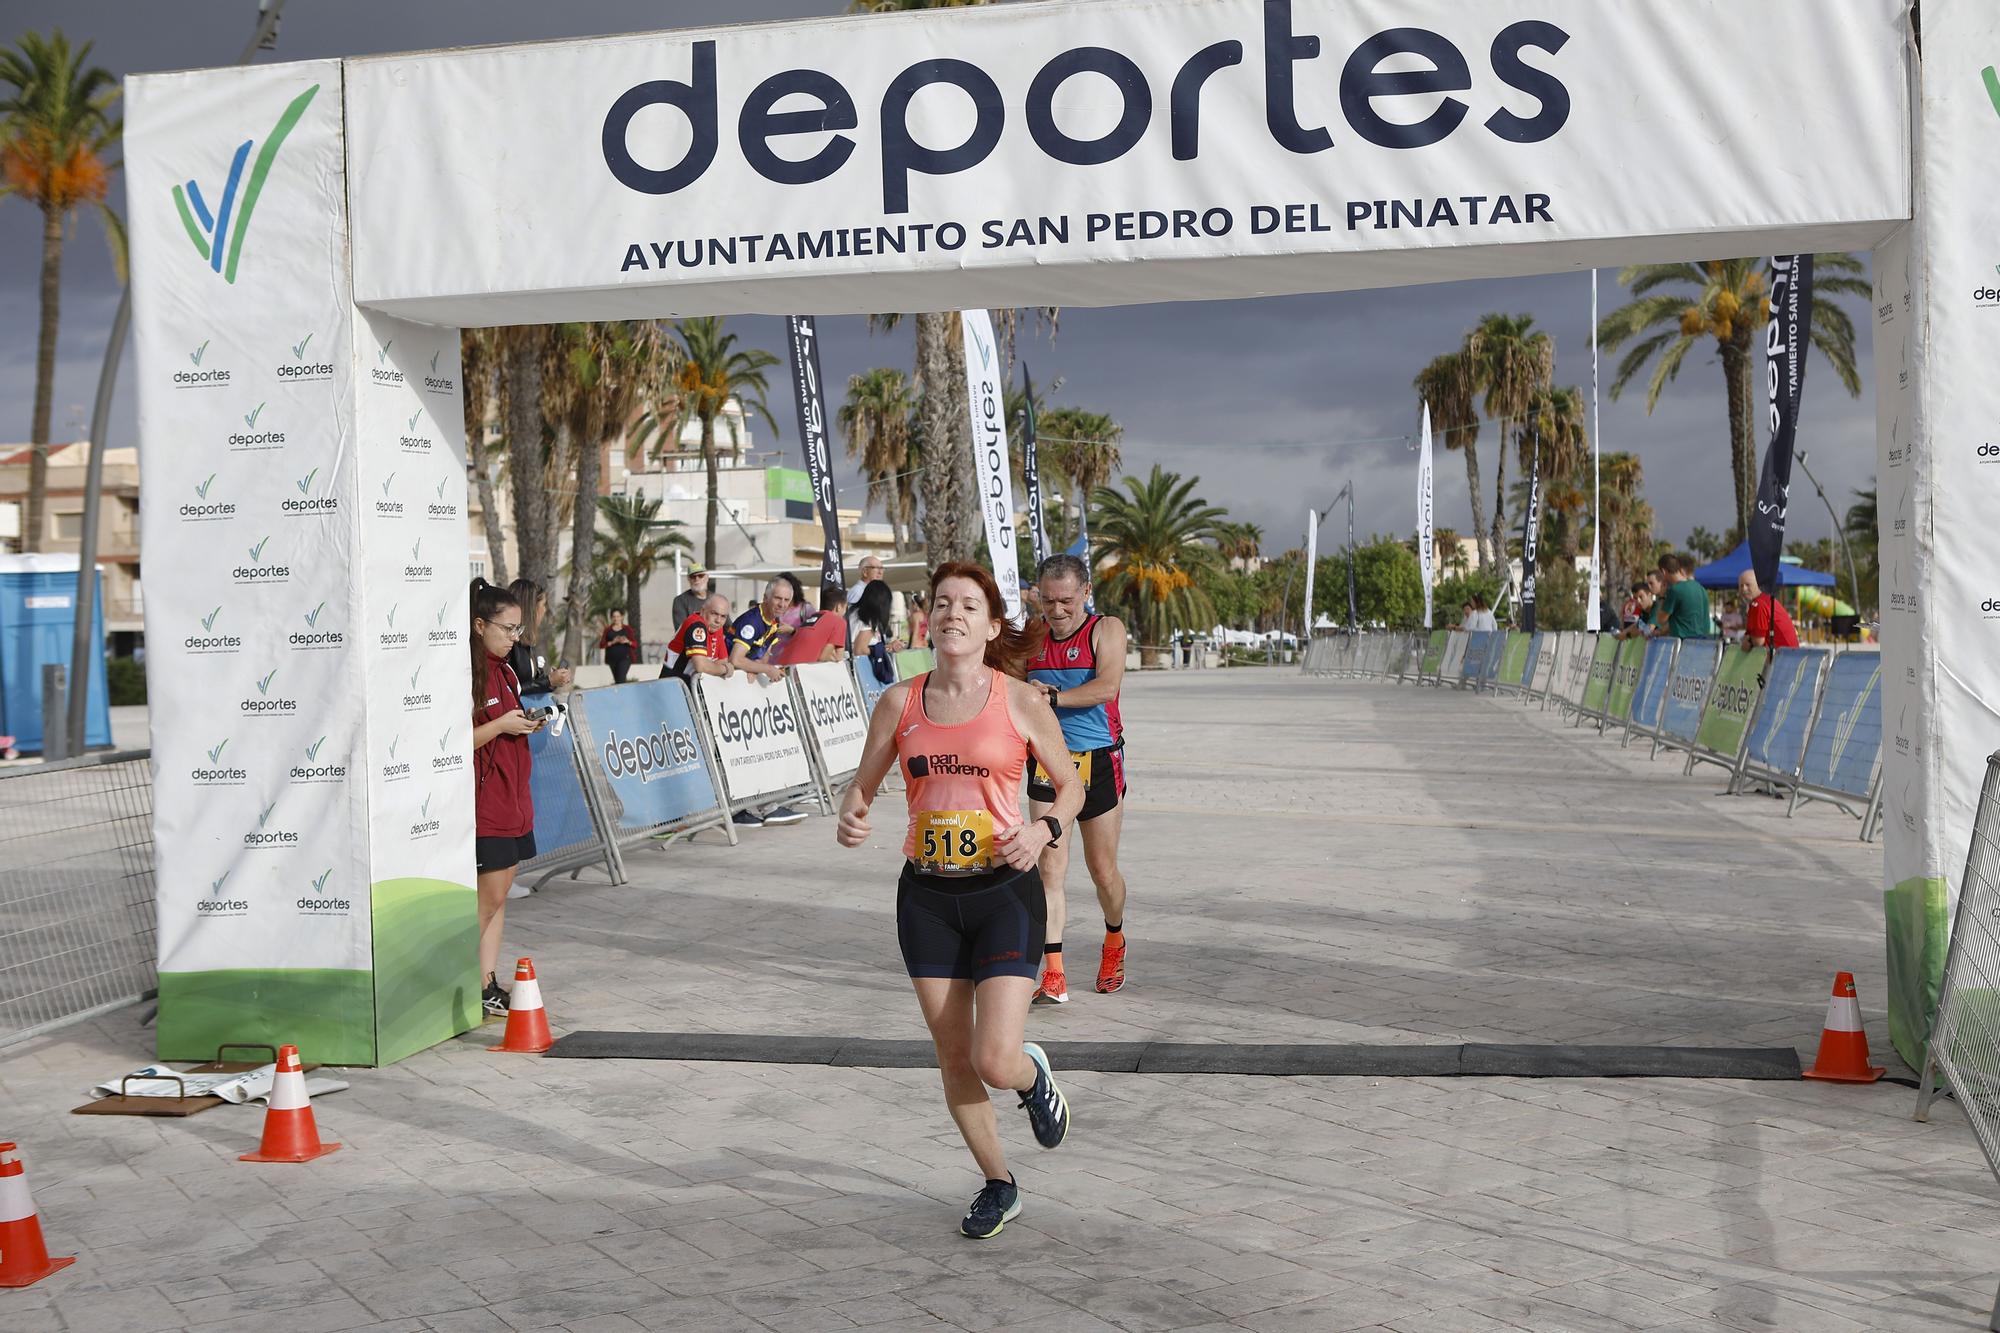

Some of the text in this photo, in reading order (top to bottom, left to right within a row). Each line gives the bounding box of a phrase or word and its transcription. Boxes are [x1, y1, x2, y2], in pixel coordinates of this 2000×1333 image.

[602, 0, 1571, 213] deportes
[621, 191, 1555, 272] AYUNTAMIENTO SAN PEDRO DEL PINATAR
[1789, 293, 1799, 323] SAN
[172, 368, 230, 384] deportes
[276, 361, 333, 378] deportes
[371, 367, 403, 382] deportes
[228, 431, 285, 447] deportes
[399, 434, 431, 449] deportes
[179, 501, 235, 517] deportes
[281, 496, 337, 512] deportes
[375, 500, 403, 513] deportes
[427, 502, 456, 516] deportes
[232, 564, 289, 580] deportes
[404, 564, 432, 578] deportes
[184, 634, 241, 650] deportes
[288, 630, 343, 646] deportes
[379, 631, 408, 645] deportes
[427, 629, 457, 642] deportes
[240, 697, 296, 713] deportes
[402, 692, 431, 707] deportes
[810, 686, 858, 733] deportes
[718, 697, 796, 750] deportes
[432, 753, 463, 768] deportes
[605, 721, 699, 785] deportes
[930, 752, 959, 769] pan
[191, 767, 246, 781] deportes
[289, 764, 345, 780] deportes
[932, 763, 990, 779] moreno
[243, 830, 298, 845] deportes
[924, 829, 978, 857] 518
[196, 899, 248, 913] deportes
[296, 896, 350, 911] deportes
